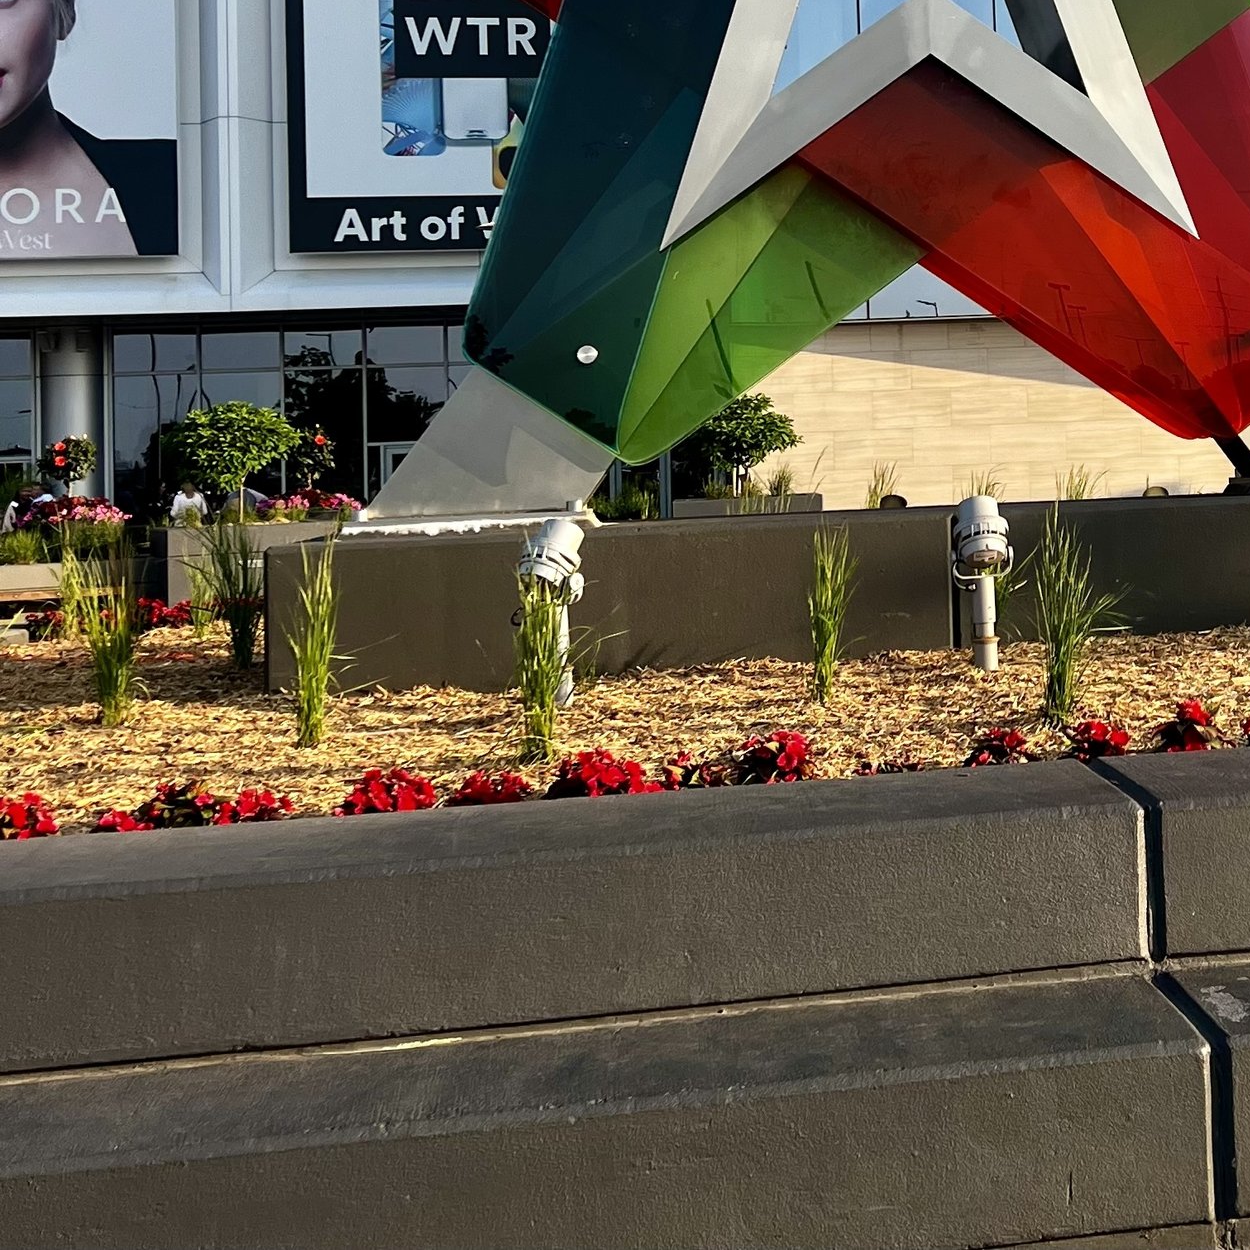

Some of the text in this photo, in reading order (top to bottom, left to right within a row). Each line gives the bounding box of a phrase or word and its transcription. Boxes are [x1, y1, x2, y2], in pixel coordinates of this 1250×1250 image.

[404, 16, 538, 56] WTR
[0, 187, 127, 225] ORA
[333, 207, 407, 242] Art
[420, 205, 465, 241] of
